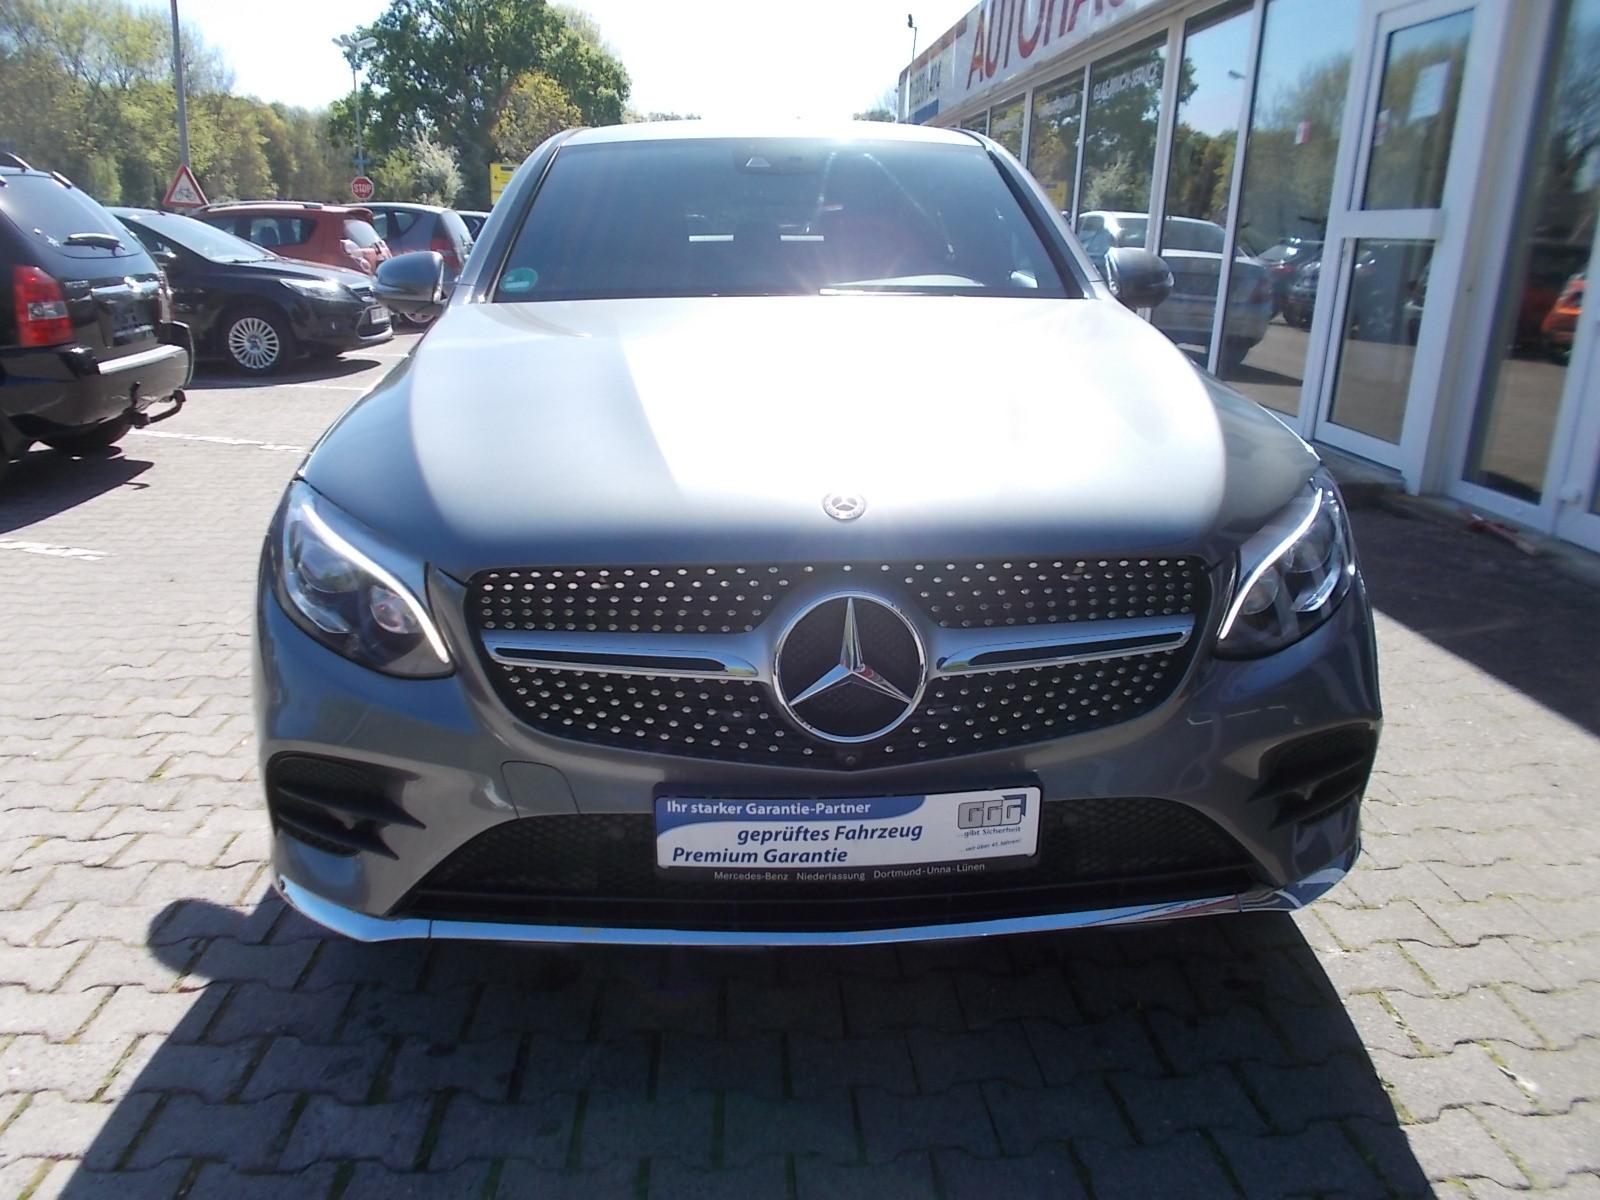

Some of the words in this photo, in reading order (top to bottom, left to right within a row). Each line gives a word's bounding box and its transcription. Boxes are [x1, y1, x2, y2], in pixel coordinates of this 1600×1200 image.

[353, 183, 371, 193] STOP
[667, 800, 688, 813] Ihr
[691, 802, 741, 815] starker
[746, 803, 871, 815] Garantie-Partner
[737, 826, 830, 845] geprüftes
[834, 824, 923, 841] Fahrzeug
[672, 847, 758, 863] Premium
[764, 847, 848, 864] Garantie
[714, 872, 789, 880] Mercedes-Benz
[796, 872, 865, 881] Niederlassung
